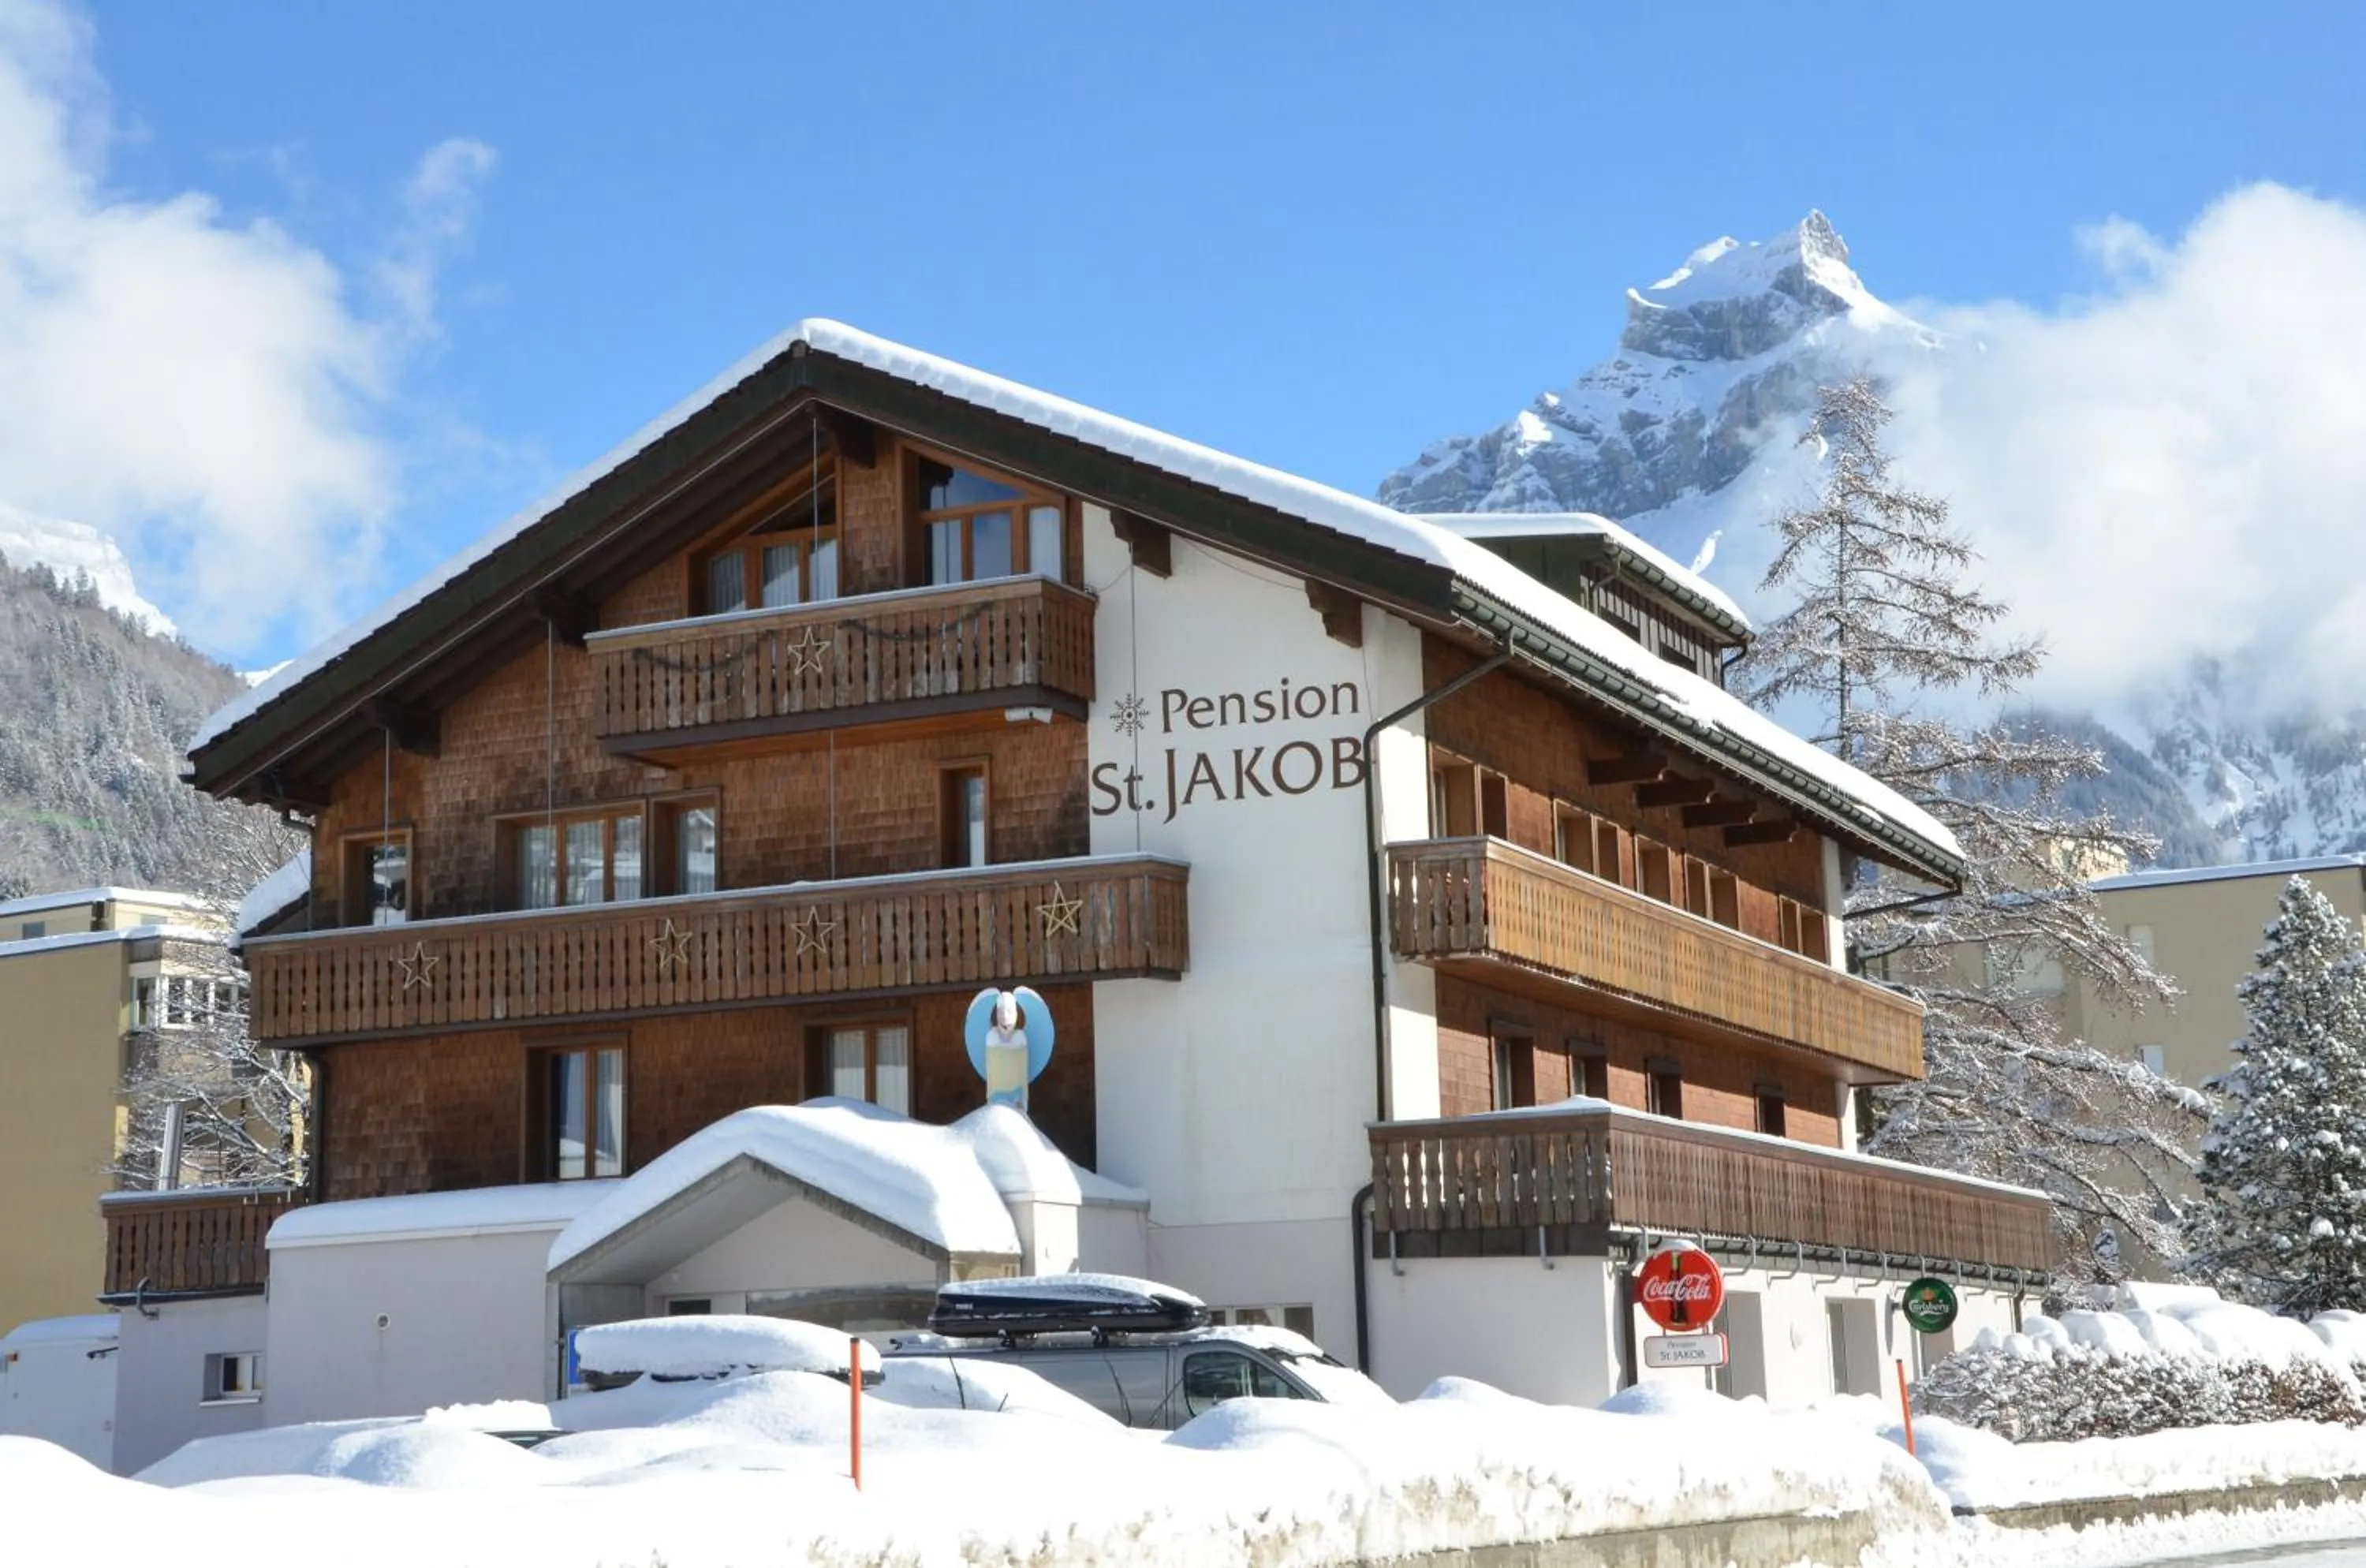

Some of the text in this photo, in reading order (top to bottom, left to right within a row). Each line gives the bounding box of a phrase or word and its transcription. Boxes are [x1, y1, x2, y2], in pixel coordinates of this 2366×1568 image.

[1161, 677, 1359, 734] Pension
[1092, 736, 1367, 824] St. JAKOB
